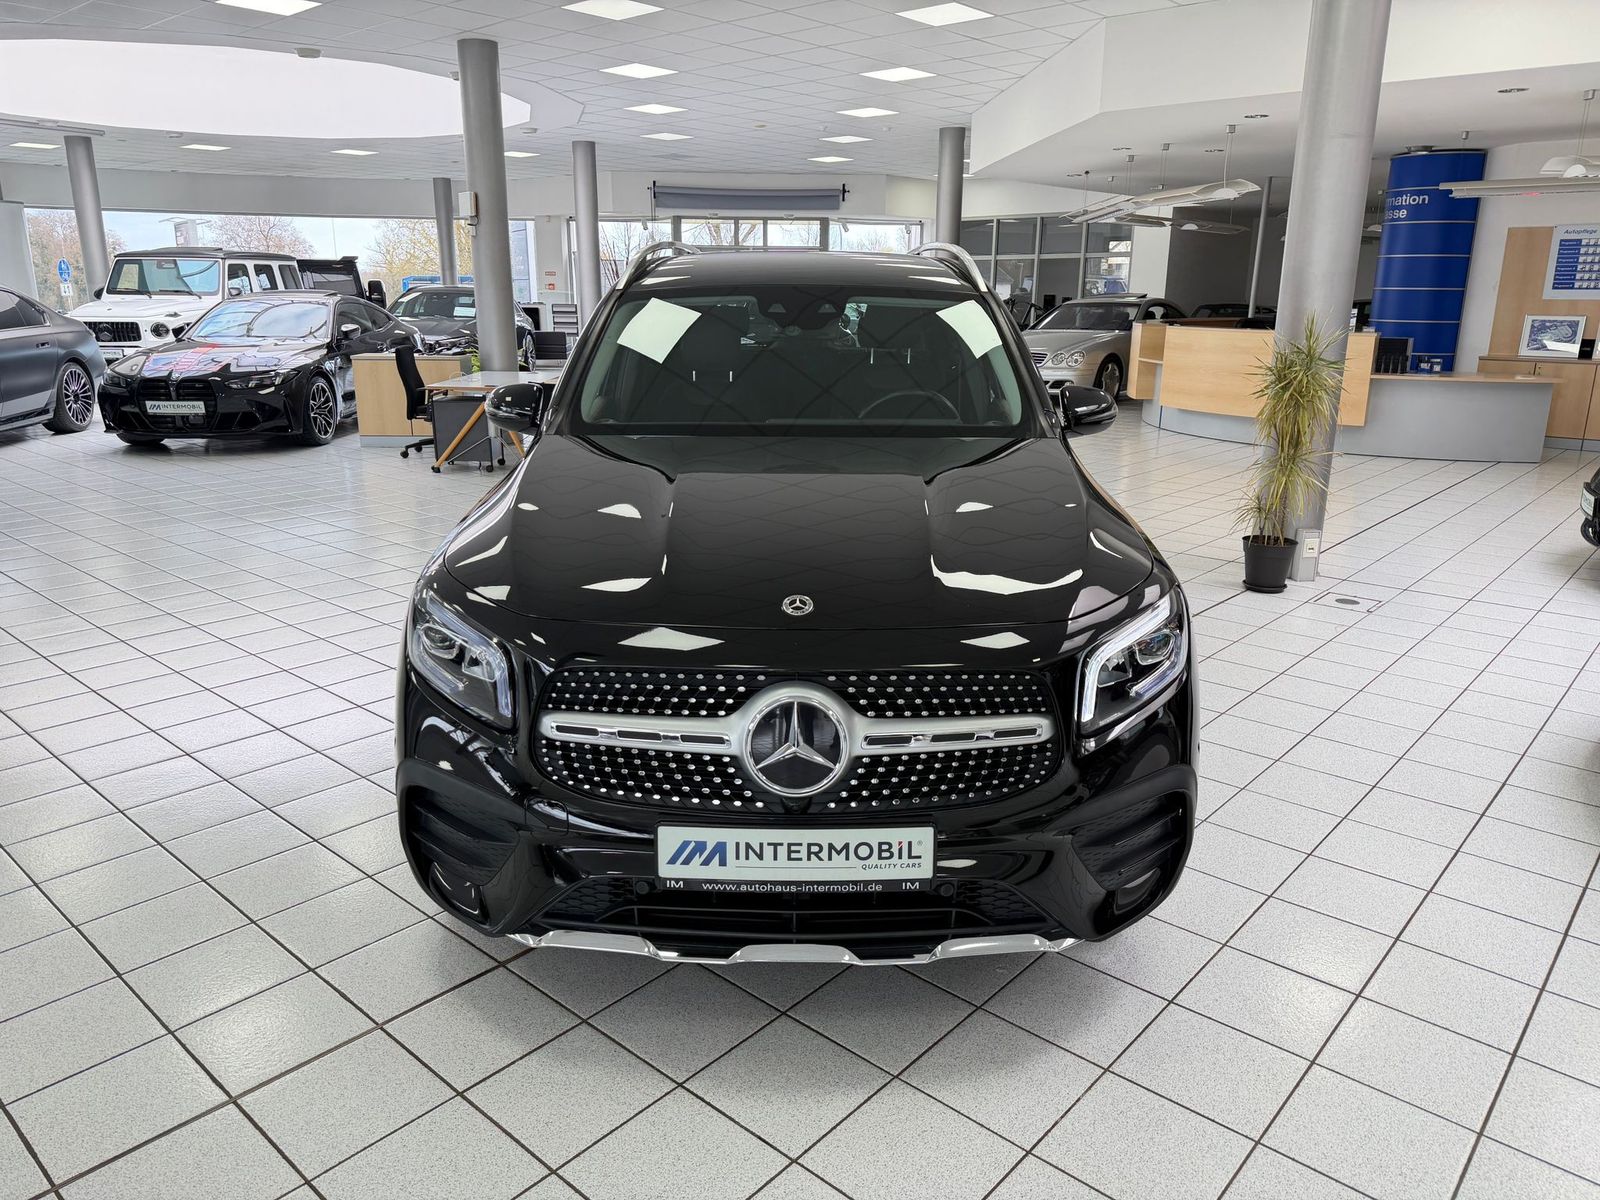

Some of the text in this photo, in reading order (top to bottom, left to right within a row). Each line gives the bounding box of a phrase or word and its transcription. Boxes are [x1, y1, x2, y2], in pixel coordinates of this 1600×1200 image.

[666, 880, 920, 892] IM www.autohaus-intermobil.de IM
